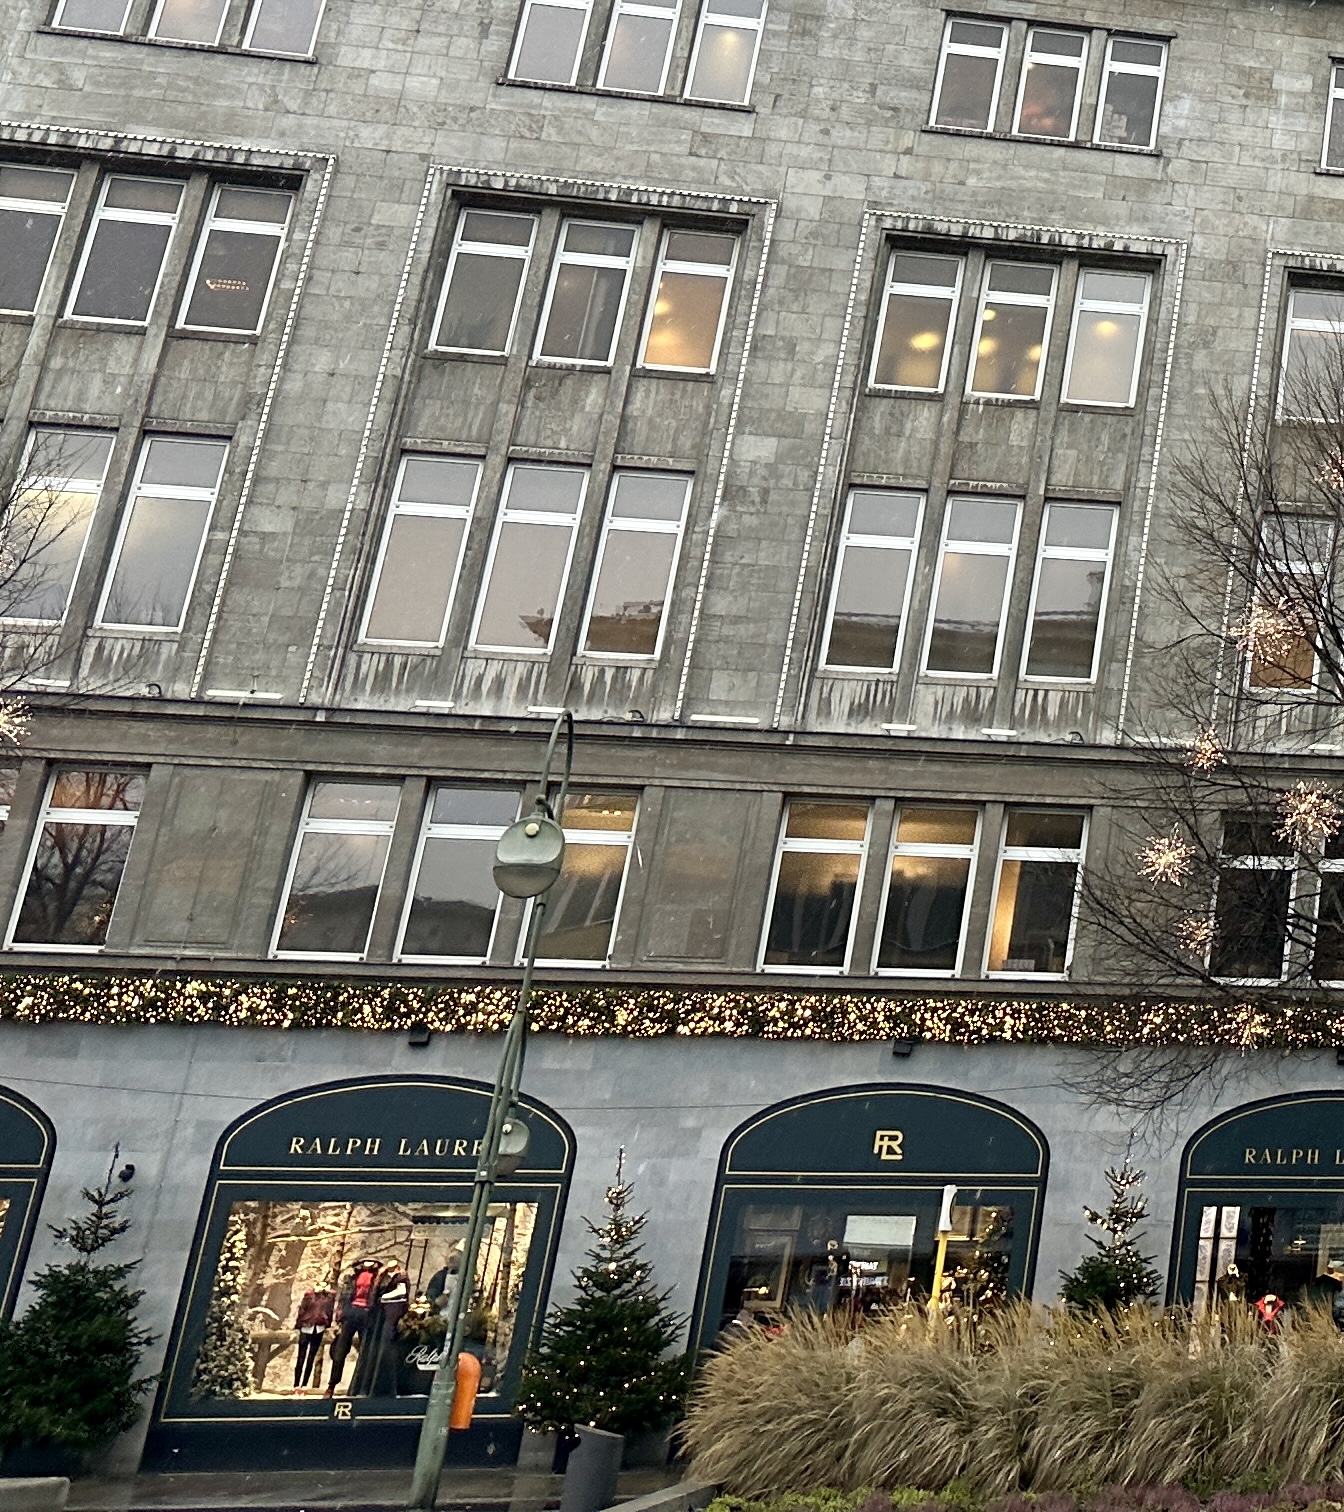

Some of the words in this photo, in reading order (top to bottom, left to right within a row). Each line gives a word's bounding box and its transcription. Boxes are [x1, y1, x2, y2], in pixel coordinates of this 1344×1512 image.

[289, 1136, 381, 1155] RALPH
[398, 1138, 484, 1156] LAURE
[1244, 1147, 1320, 1165] RALPH
